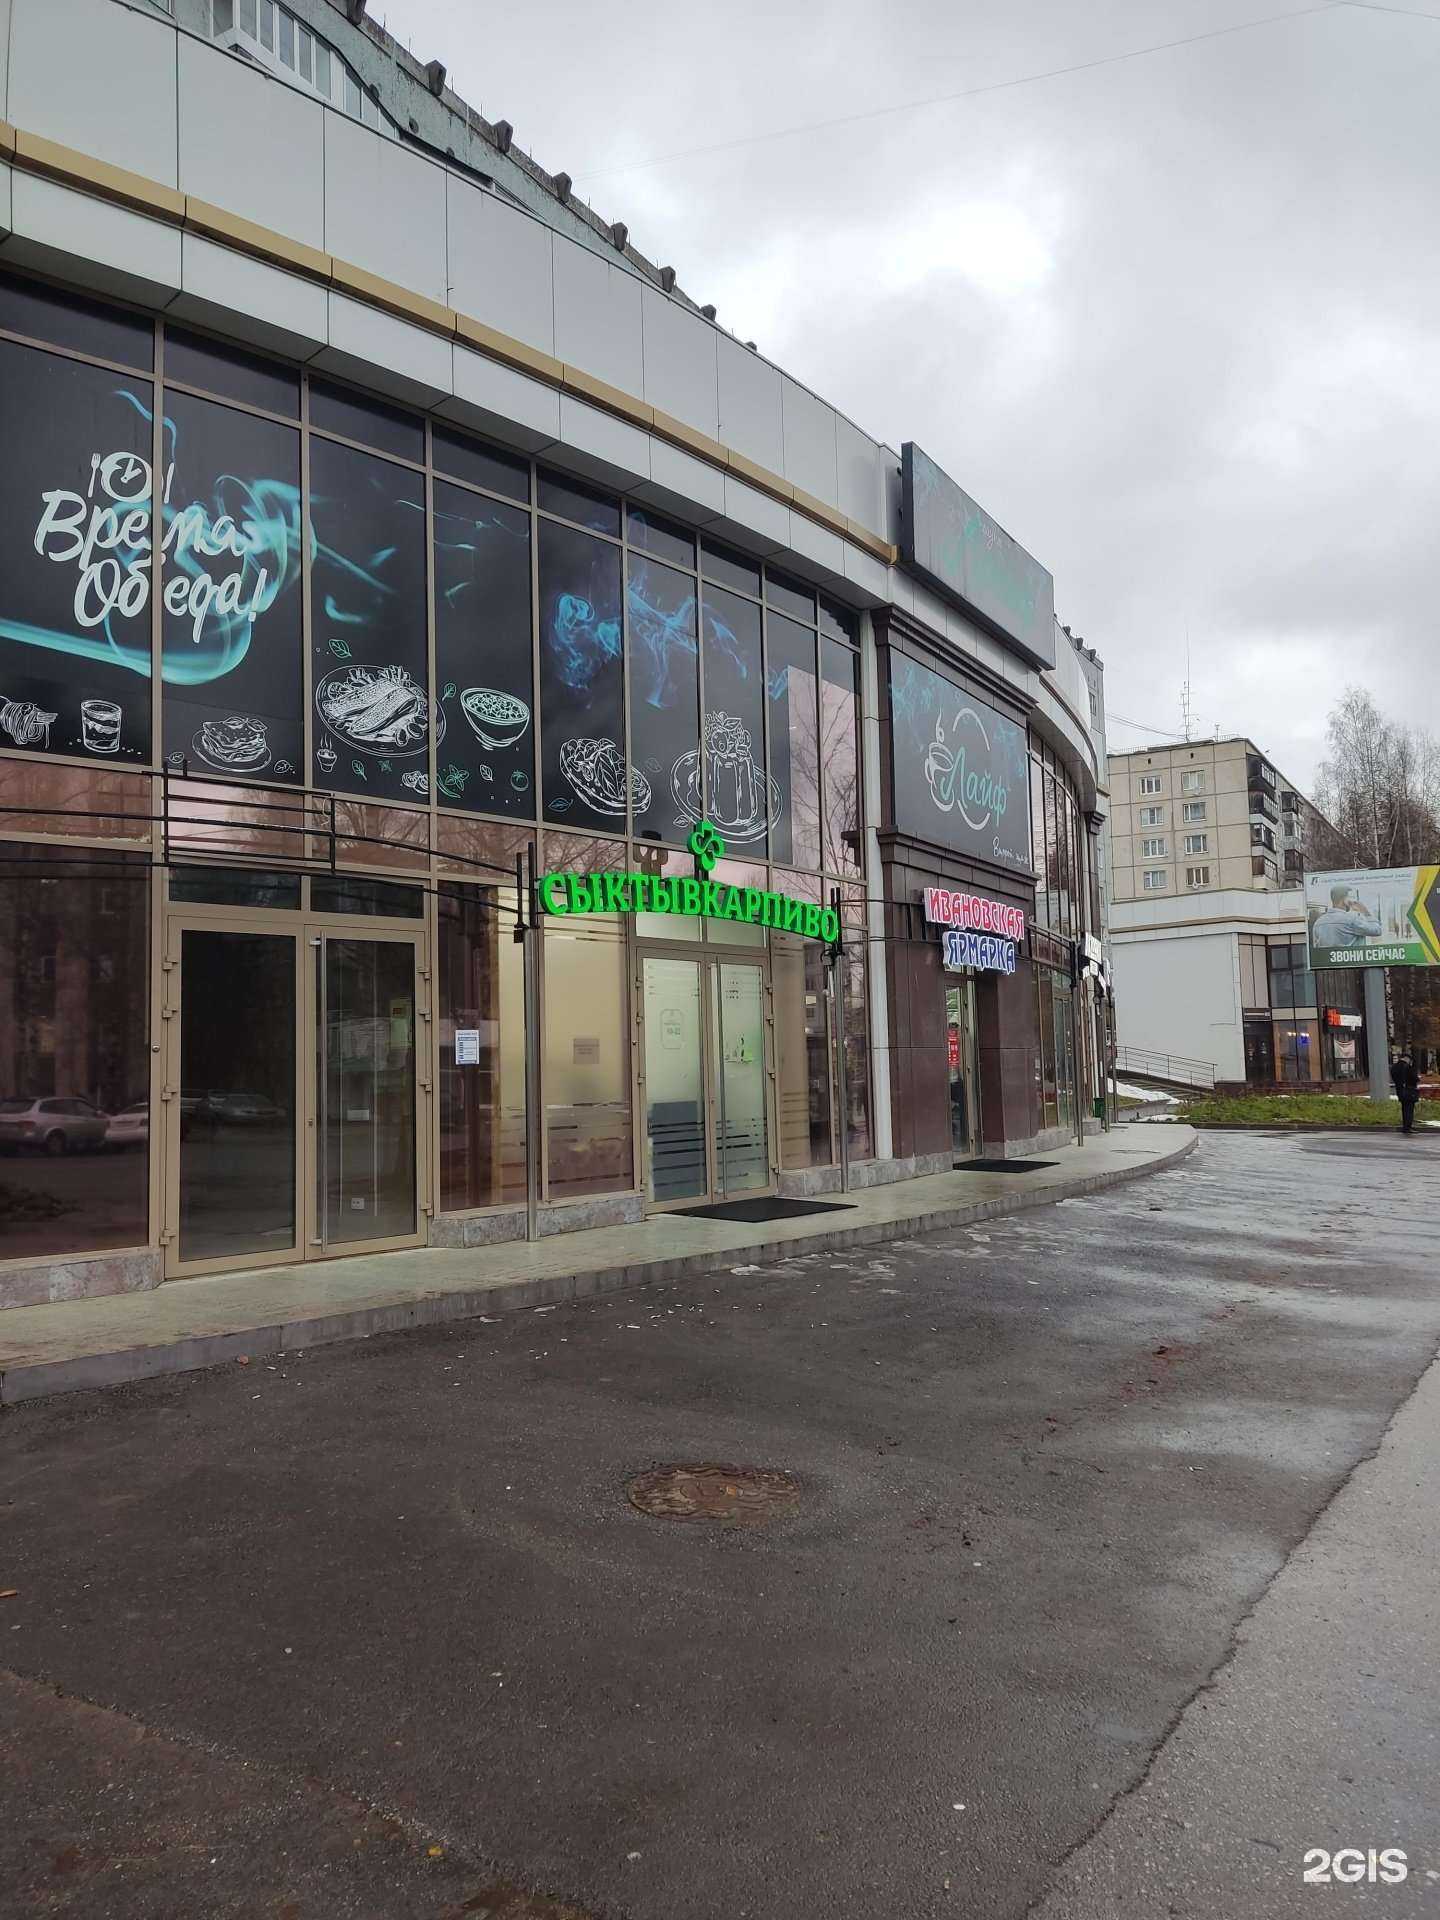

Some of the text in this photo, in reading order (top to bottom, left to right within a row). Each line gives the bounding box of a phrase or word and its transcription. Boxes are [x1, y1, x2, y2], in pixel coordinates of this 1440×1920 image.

[73, 553, 268, 644] Обеда!
[940, 746, 1008, 828] Лайф
[538, 871, 839, 944] СЫКТЫВКАРПИВО
[925, 888, 1025, 942] ИВАНОВСКАЯ
[946, 931, 1016, 975] ЯРМАРКА
[1329, 947, 1406, 963] ЗВОНИ СЕЙЧАС
